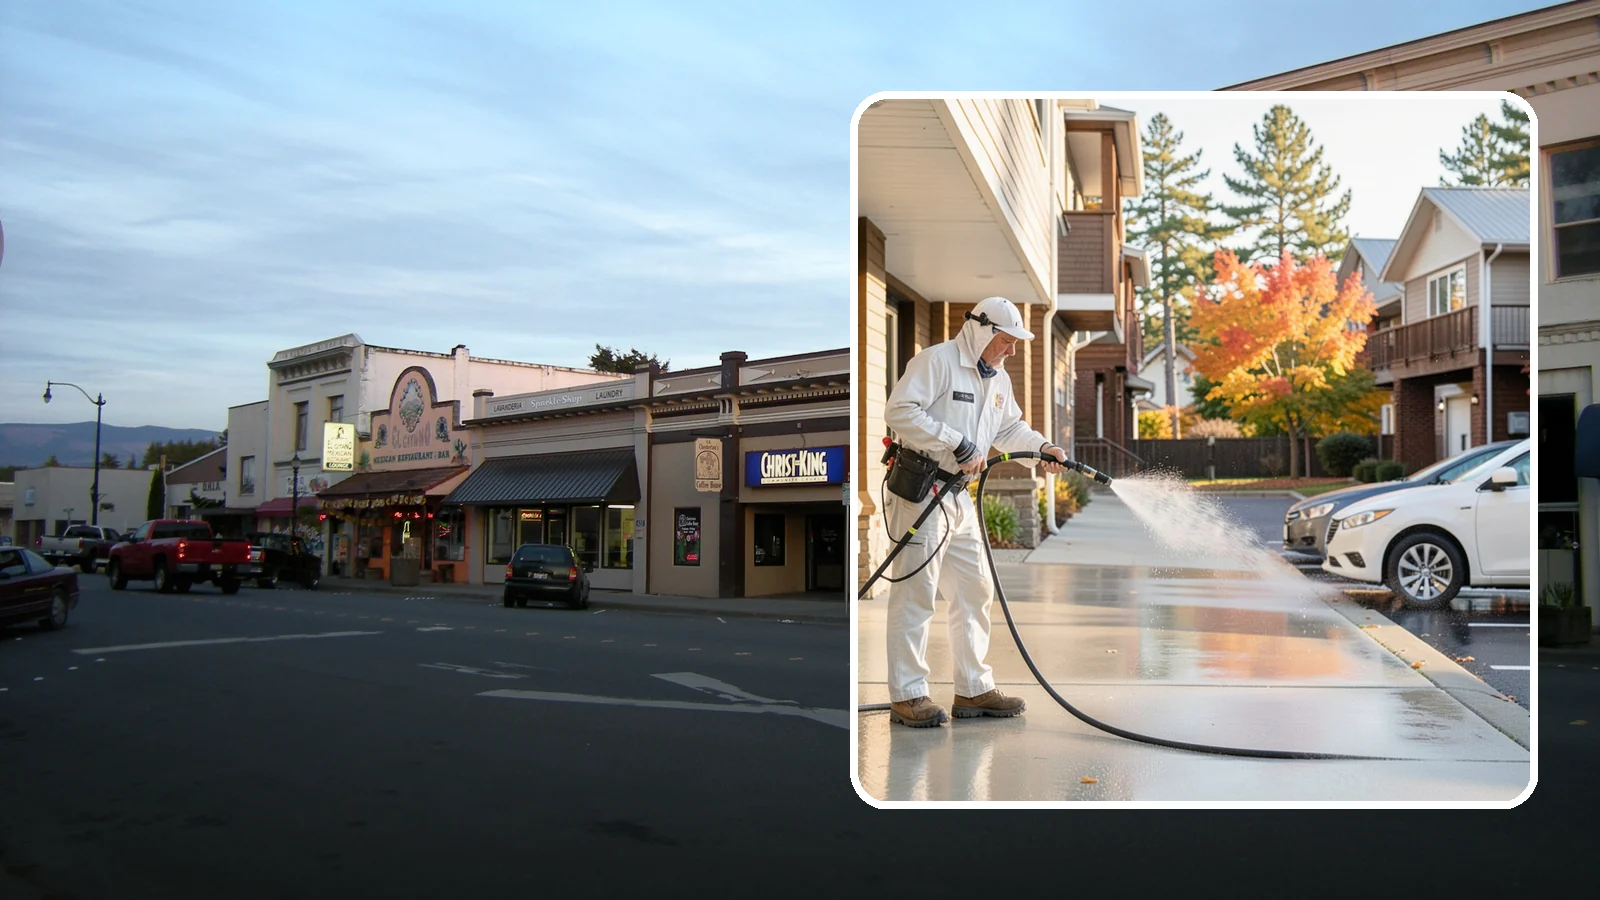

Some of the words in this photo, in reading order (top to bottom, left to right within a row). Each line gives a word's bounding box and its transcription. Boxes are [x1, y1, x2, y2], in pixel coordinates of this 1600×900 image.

[493, 402, 523, 413] LAVANDERIA
[531, 397, 561, 409] Sparkle
[562, 394, 583, 405] Shop
[595, 388, 624, 400] LAUNDRY
[392, 425, 402, 449] EL
[373, 455, 396, 464] MEXICAN
[397, 451, 433, 462] RESTAURANT
[438, 450, 450, 459] BAR
[761, 452, 798, 478] CHRIST
[799, 449, 828, 476] KING
